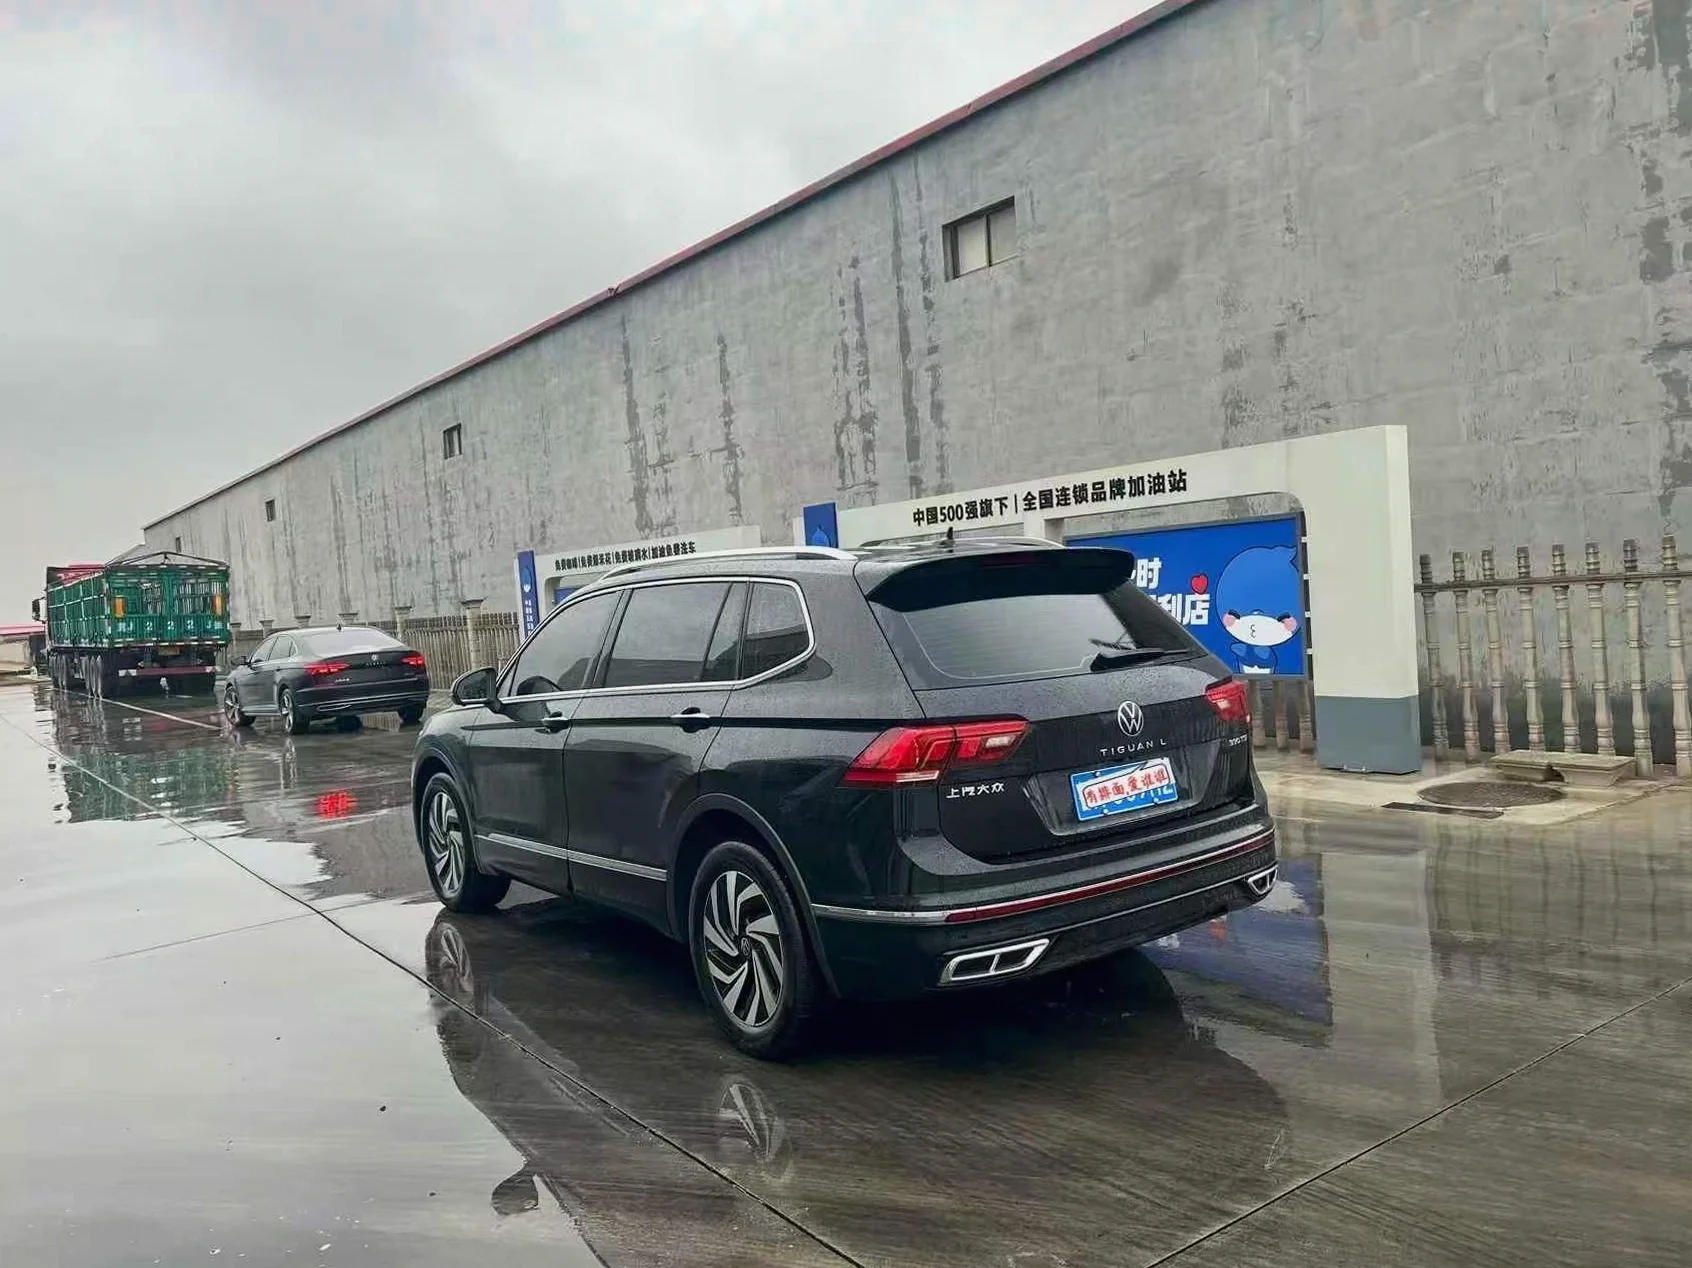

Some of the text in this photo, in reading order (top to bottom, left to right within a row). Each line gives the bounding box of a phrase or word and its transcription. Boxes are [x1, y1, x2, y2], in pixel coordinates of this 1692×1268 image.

[912, 468, 1188, 526] 中国500强旗下 全国连锁品牌加油站
[1130, 557, 1162, 590] 时
[1149, 593, 1210, 625] 利店
[1100, 738, 1167, 757] TIGUAN L
[945, 782, 1005, 799] 上汽大众
